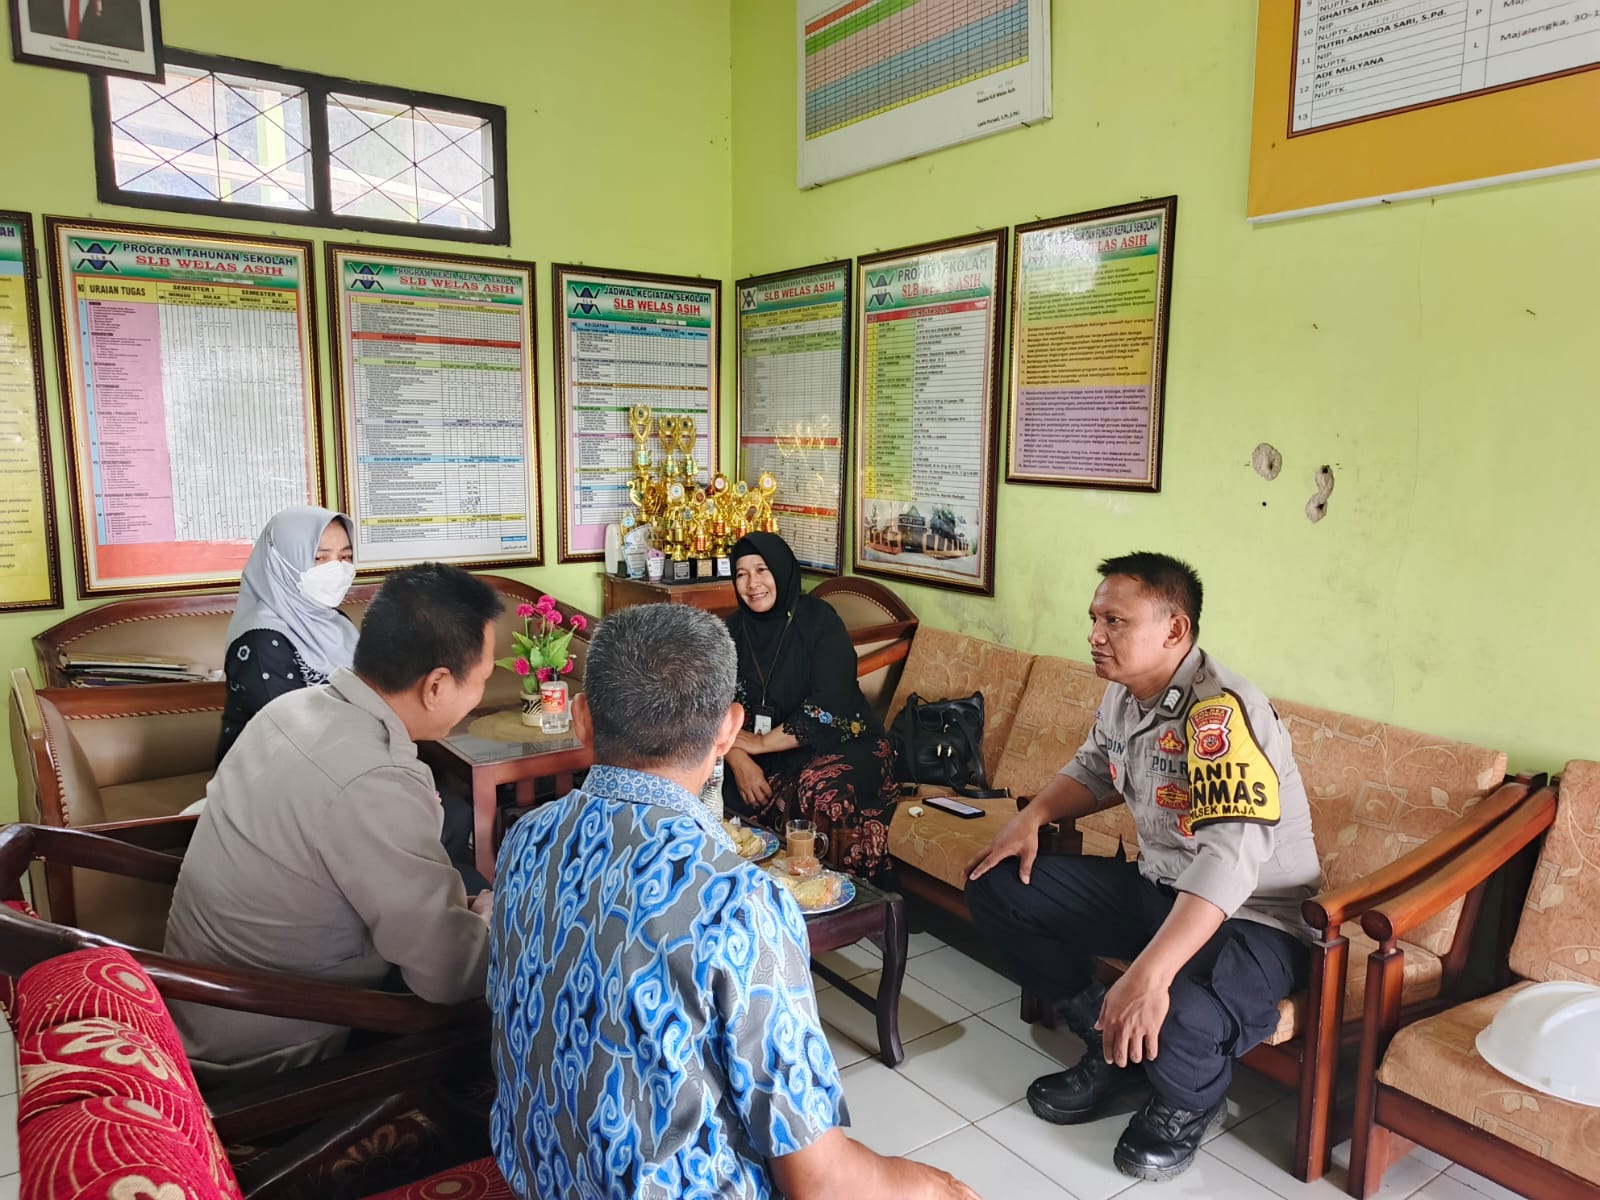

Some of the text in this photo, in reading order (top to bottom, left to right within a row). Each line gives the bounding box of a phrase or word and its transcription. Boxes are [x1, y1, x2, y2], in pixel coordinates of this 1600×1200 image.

[1319, 5, 1359, 21] GHAITSA
[1476, 8, 1482, 16] P
[1304, 28, 1313, 36] 10
[1317, 39, 1344, 50] PUTRI
[1346, 25, 1391, 42] AMANDA
[1393, 17, 1418, 30] SARI,
[1421, 9, 1447, 21] S.Pd.
[1500, 19, 1569, 41] Majalengka,
[1302, 57, 1311, 65] 11
[1315, 57, 1384, 80] ADE MULYANA
[1121, 234, 1148, 248] ASIH
[123, 243, 293, 266] PROGRAM TAHUNAN SEKOLAH
[136, 255, 171, 267] SLB
[177, 258, 238, 273] WELAS
[243, 265, 284, 277] ASIH
[90, 284, 146, 296] URAIAN TUGAS
[399, 275, 427, 287] SLB
[431, 278, 479, 291] WELAS
[483, 283, 515, 295] ASIH
[764, 292, 779, 302] SLB
[782, 285, 811, 298] WELAS
[814, 281, 835, 294] ASIH
[902, 282, 918, 298] SLB
[604, 287, 709, 304] JADWAL KEGIATAN SEKOLAH
[614, 299, 700, 316] SLB WELAS ASIH
[1222, 804, 1256, 816] MAJA
